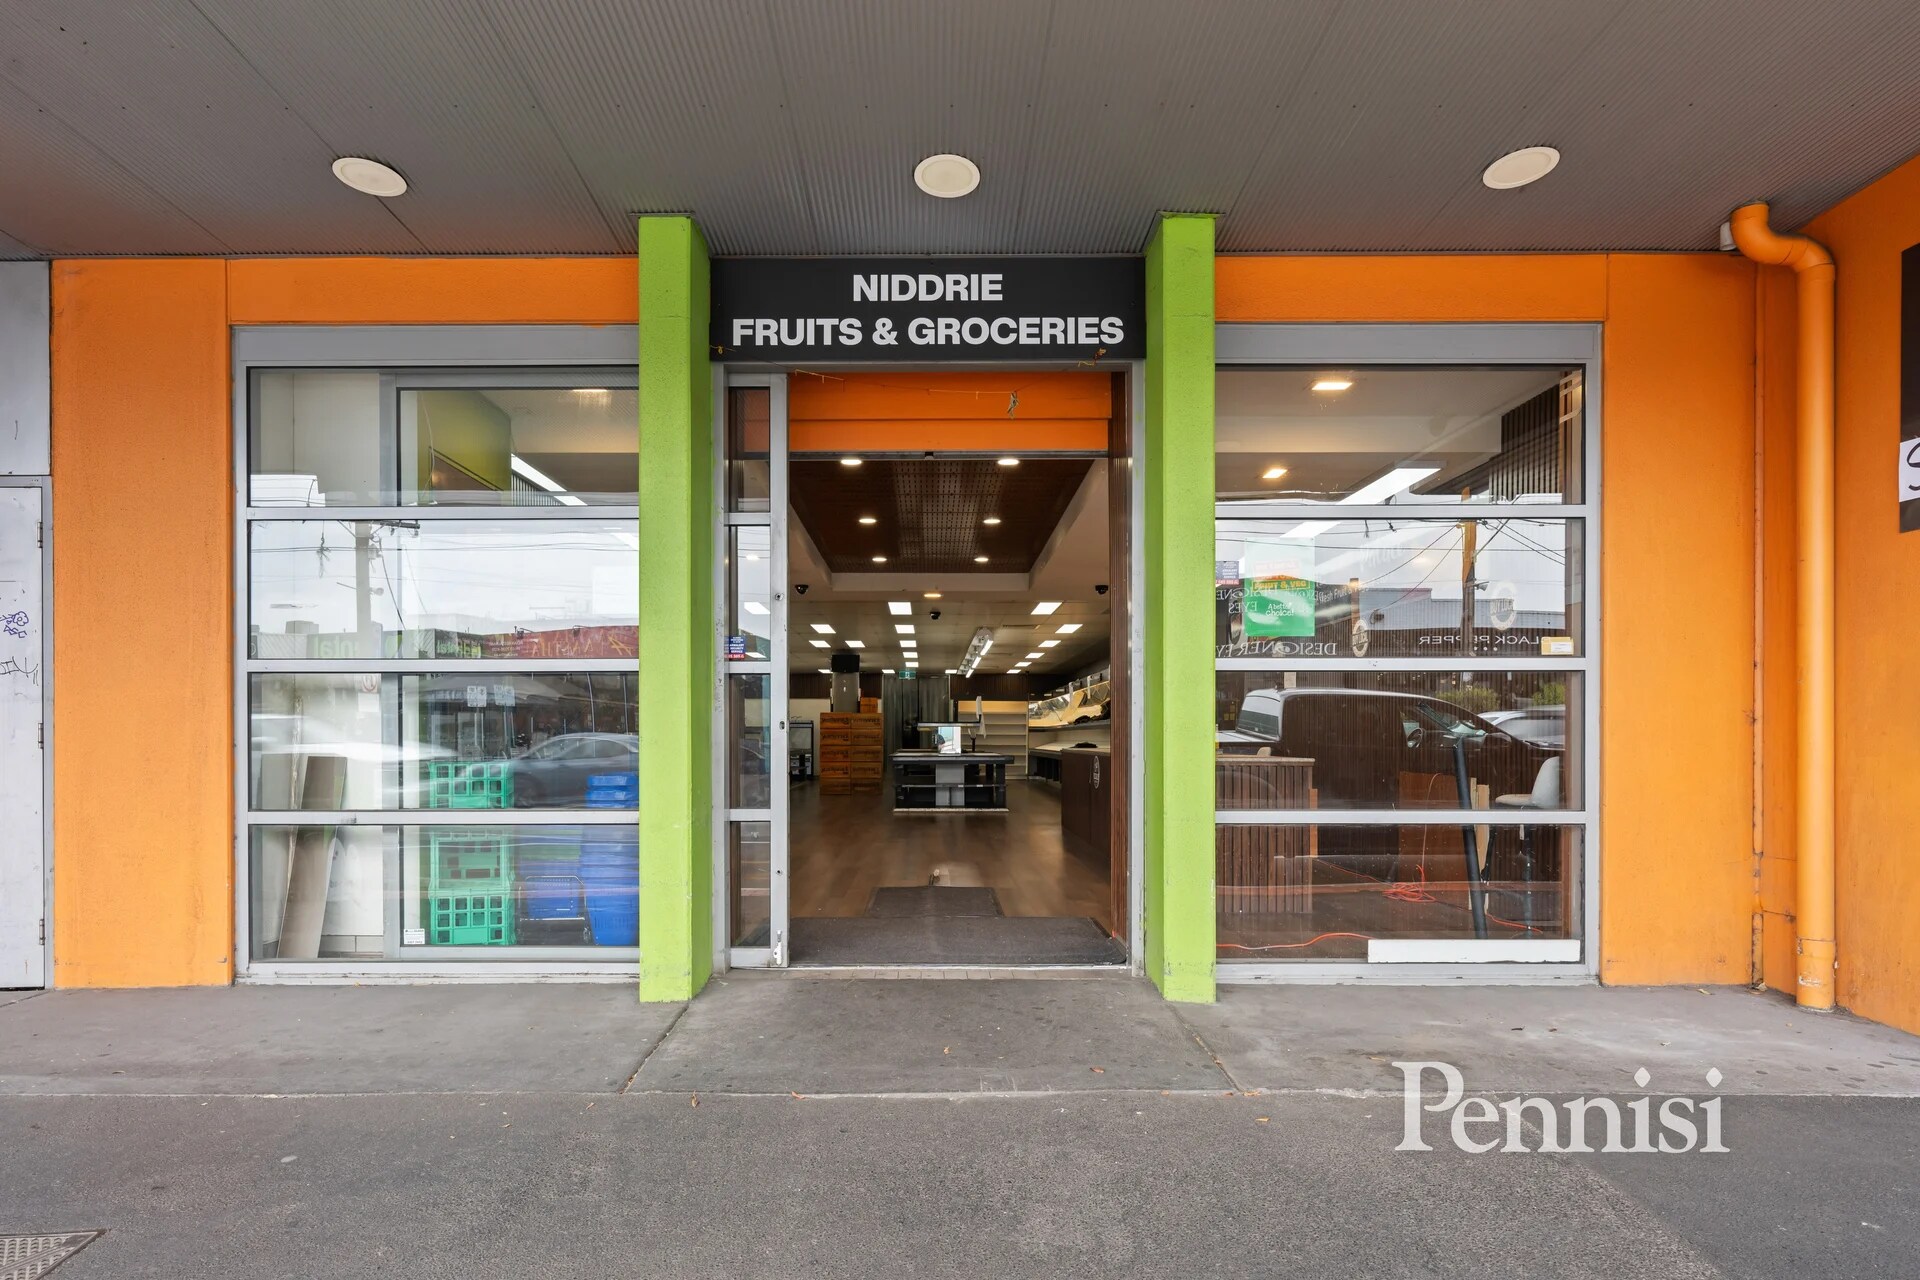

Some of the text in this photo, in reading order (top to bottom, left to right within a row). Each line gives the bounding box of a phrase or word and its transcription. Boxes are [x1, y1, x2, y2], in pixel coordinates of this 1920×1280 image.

[852, 273, 1003, 302] NIDDRIE
[732, 316, 1124, 347] FRUITS & GROCERIES
